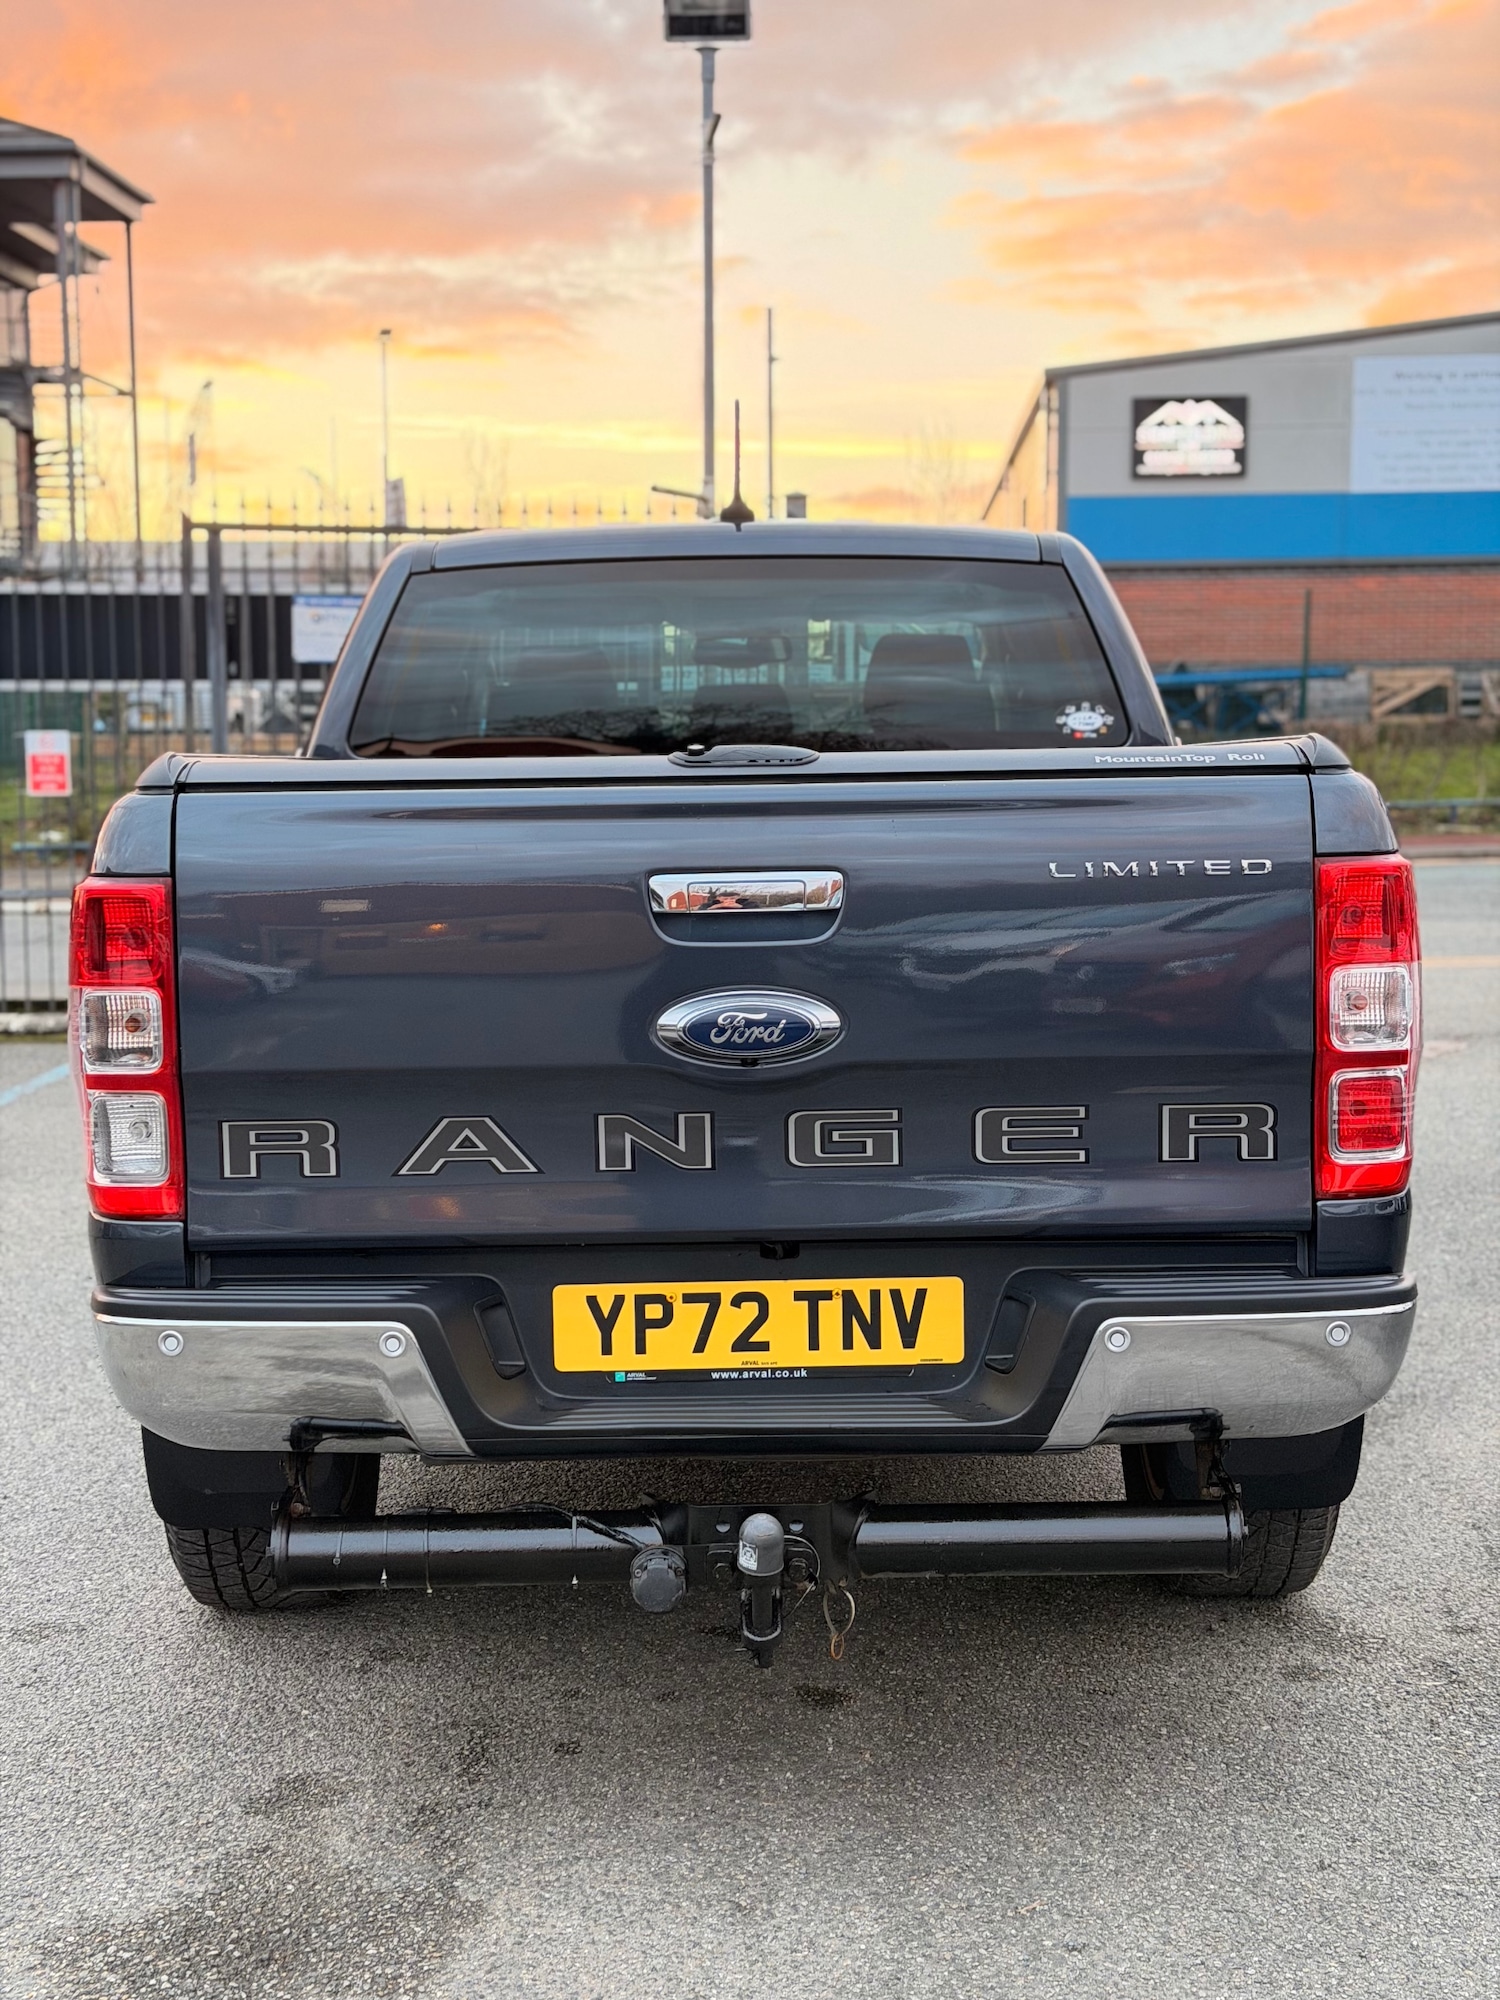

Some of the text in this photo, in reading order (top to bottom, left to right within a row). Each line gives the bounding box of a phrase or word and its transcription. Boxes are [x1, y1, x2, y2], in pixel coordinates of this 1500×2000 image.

[1094, 754, 1216, 764] MountainTop
[1049, 858, 1273, 878] LIMITED
[709, 1012, 787, 1044] Ford
[219, 1103, 1278, 1179] RANGER
[585, 1288, 928, 1356] YP72 TNV
[710, 1368, 808, 1379] www.arval.co.uk
